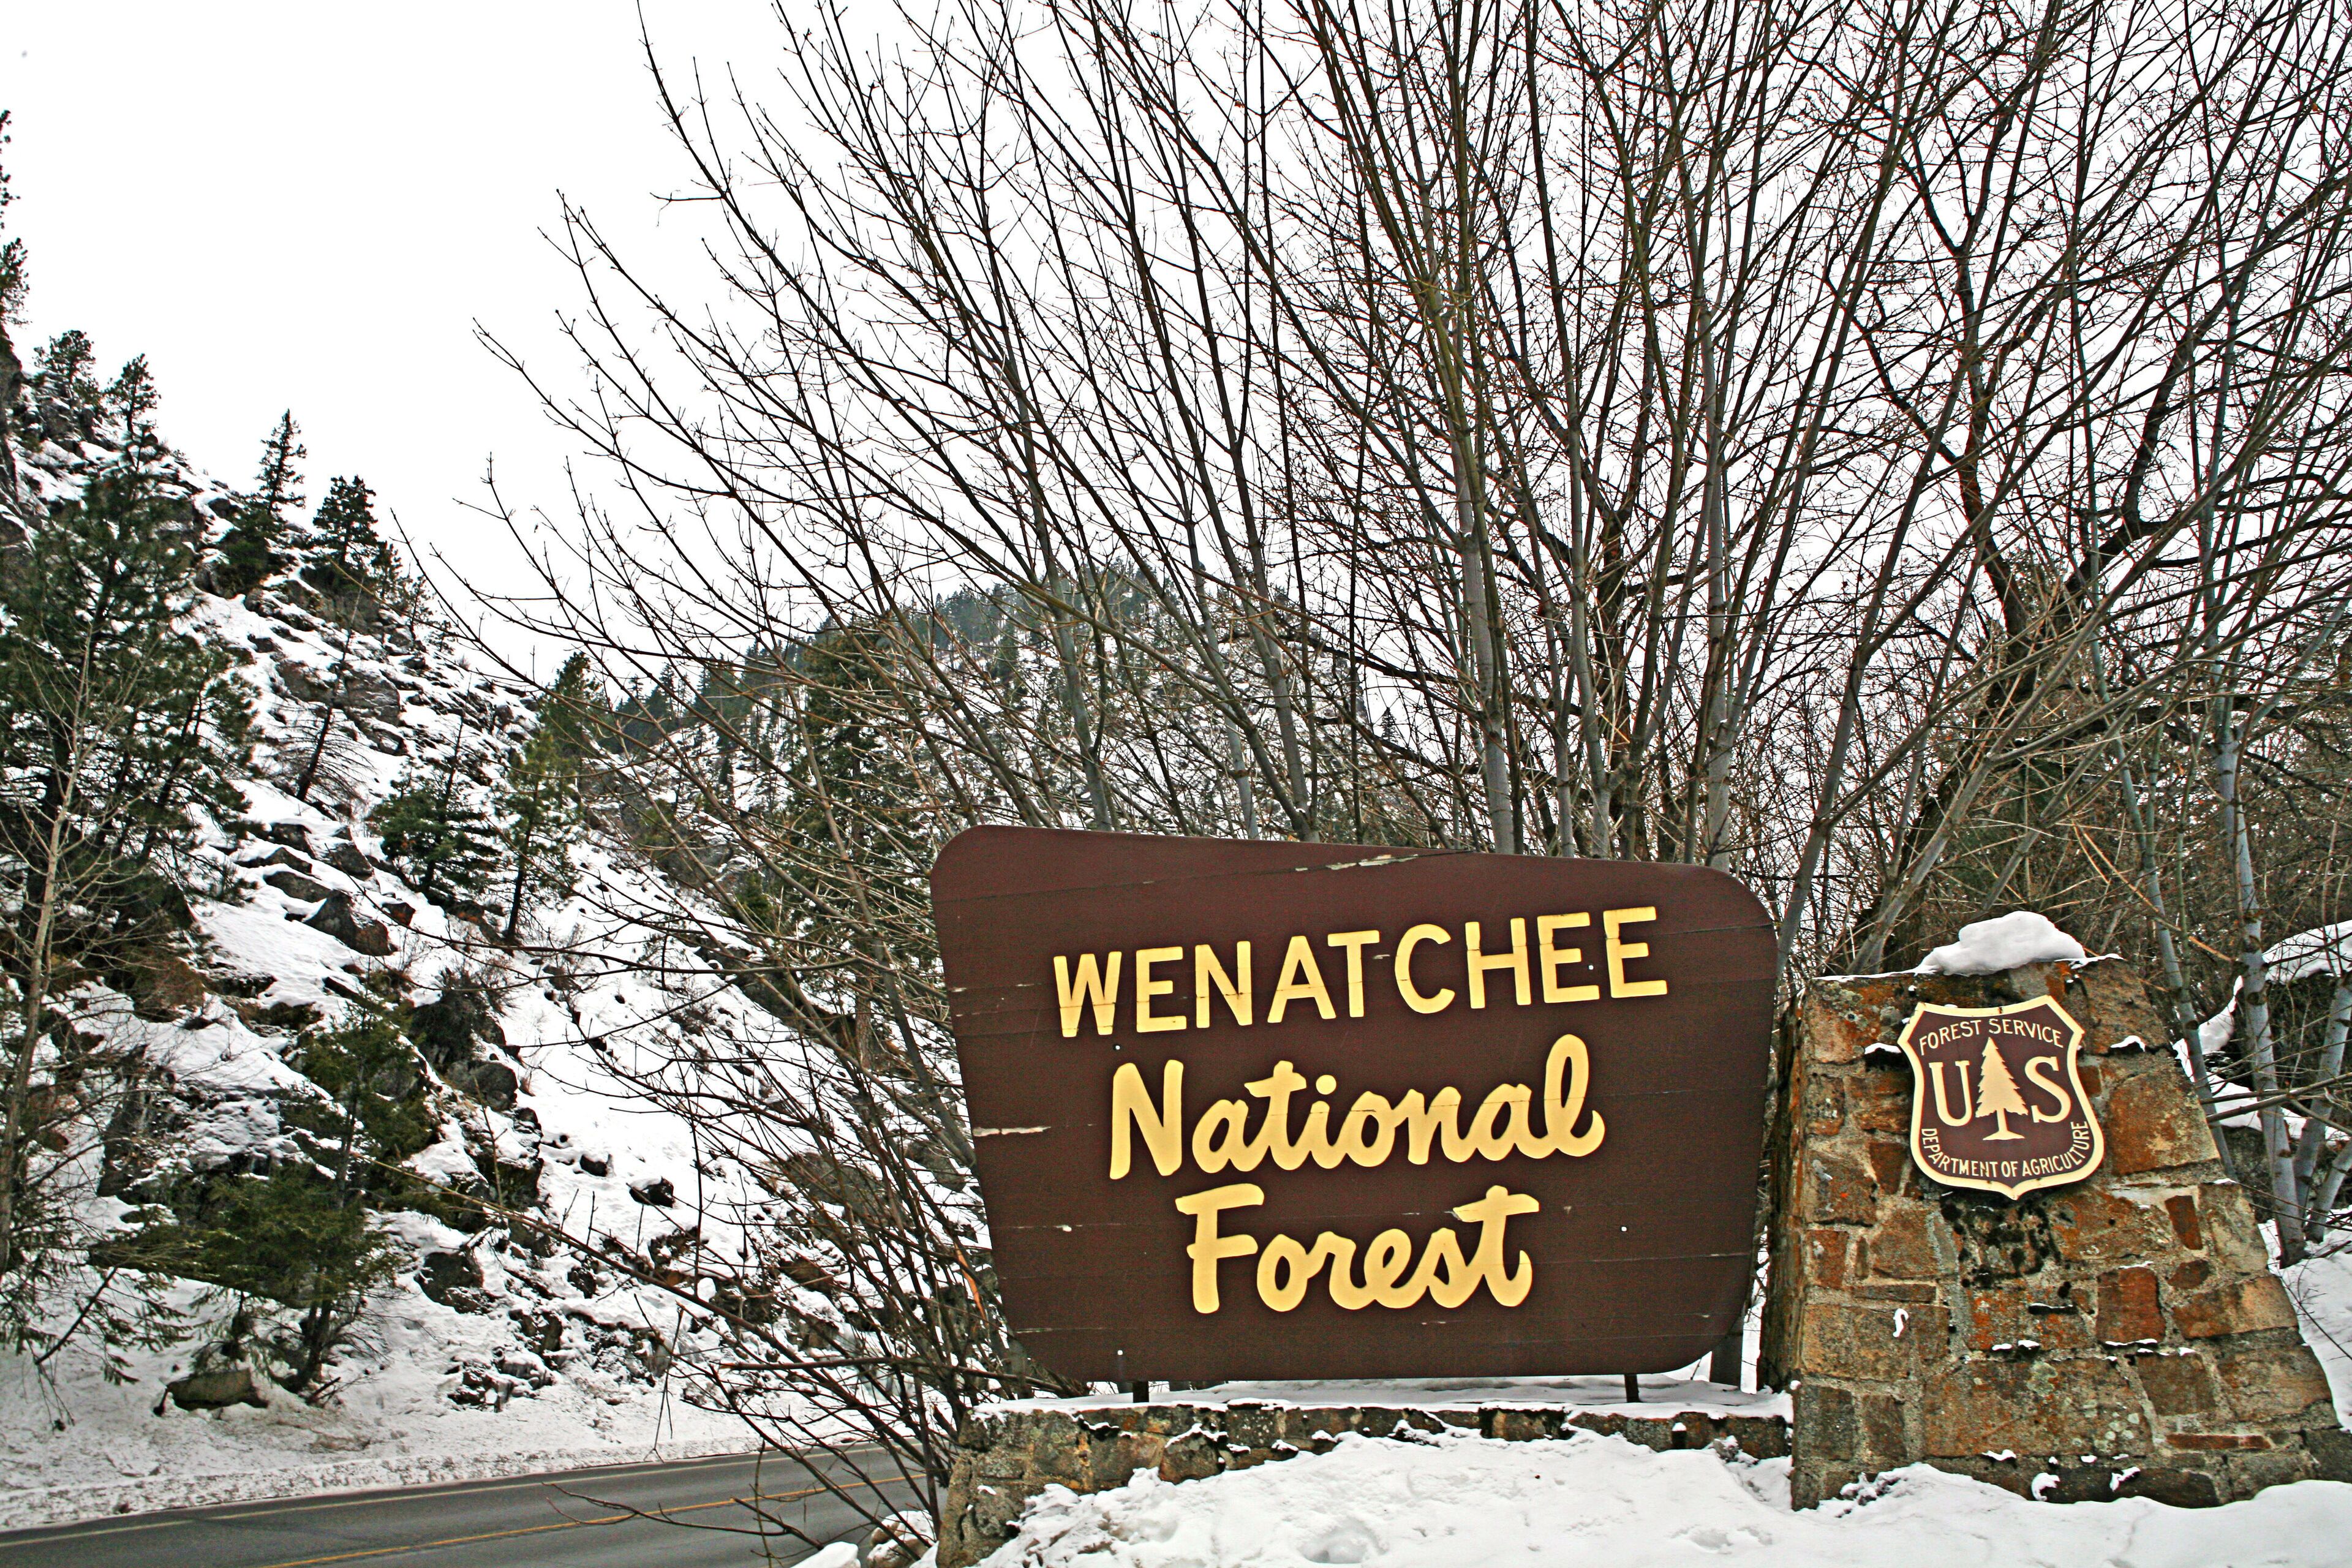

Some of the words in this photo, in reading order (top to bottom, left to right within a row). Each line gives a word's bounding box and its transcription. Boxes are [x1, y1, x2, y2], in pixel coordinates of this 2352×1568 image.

[1053, 906, 1668, 1038] WENATCHEE
[1919, 1019, 1981, 1055] FOREST
[1989, 1019, 2064, 1048] SERVICE
[1109, 1033, 1606, 1180] National
[1929, 1060, 1972, 1127] U
[2024, 1056, 2071, 1123] S
[1921, 1128, 1998, 1178] DEPARTMENT
[2001, 1161, 2018, 1178] OF
[2022, 1121, 2089, 1177] AGRICULTURE
[1175, 1183, 1540, 1314] Forest
